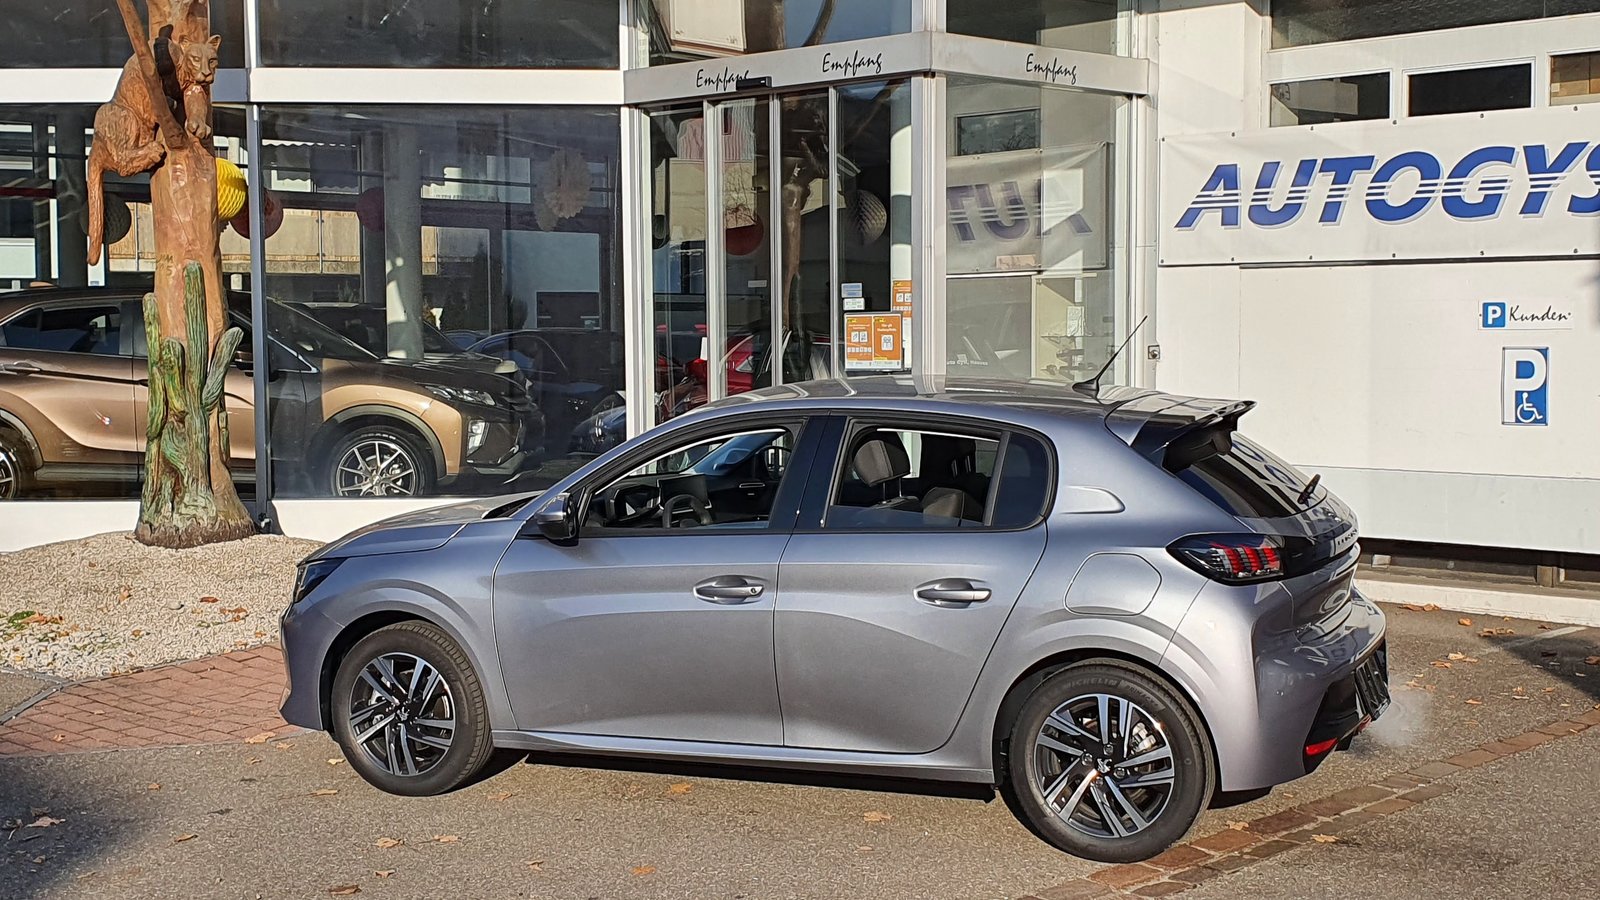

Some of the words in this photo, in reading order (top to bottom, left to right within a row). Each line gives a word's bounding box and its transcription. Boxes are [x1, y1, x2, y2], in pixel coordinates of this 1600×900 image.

[822, 49, 882, 77] Empfang
[1025, 52, 1077, 85] Empfang
[1487, 305, 1502, 325] P
[1509, 304, 1568, 322] Kunden
[1504, 349, 1547, 423] P
